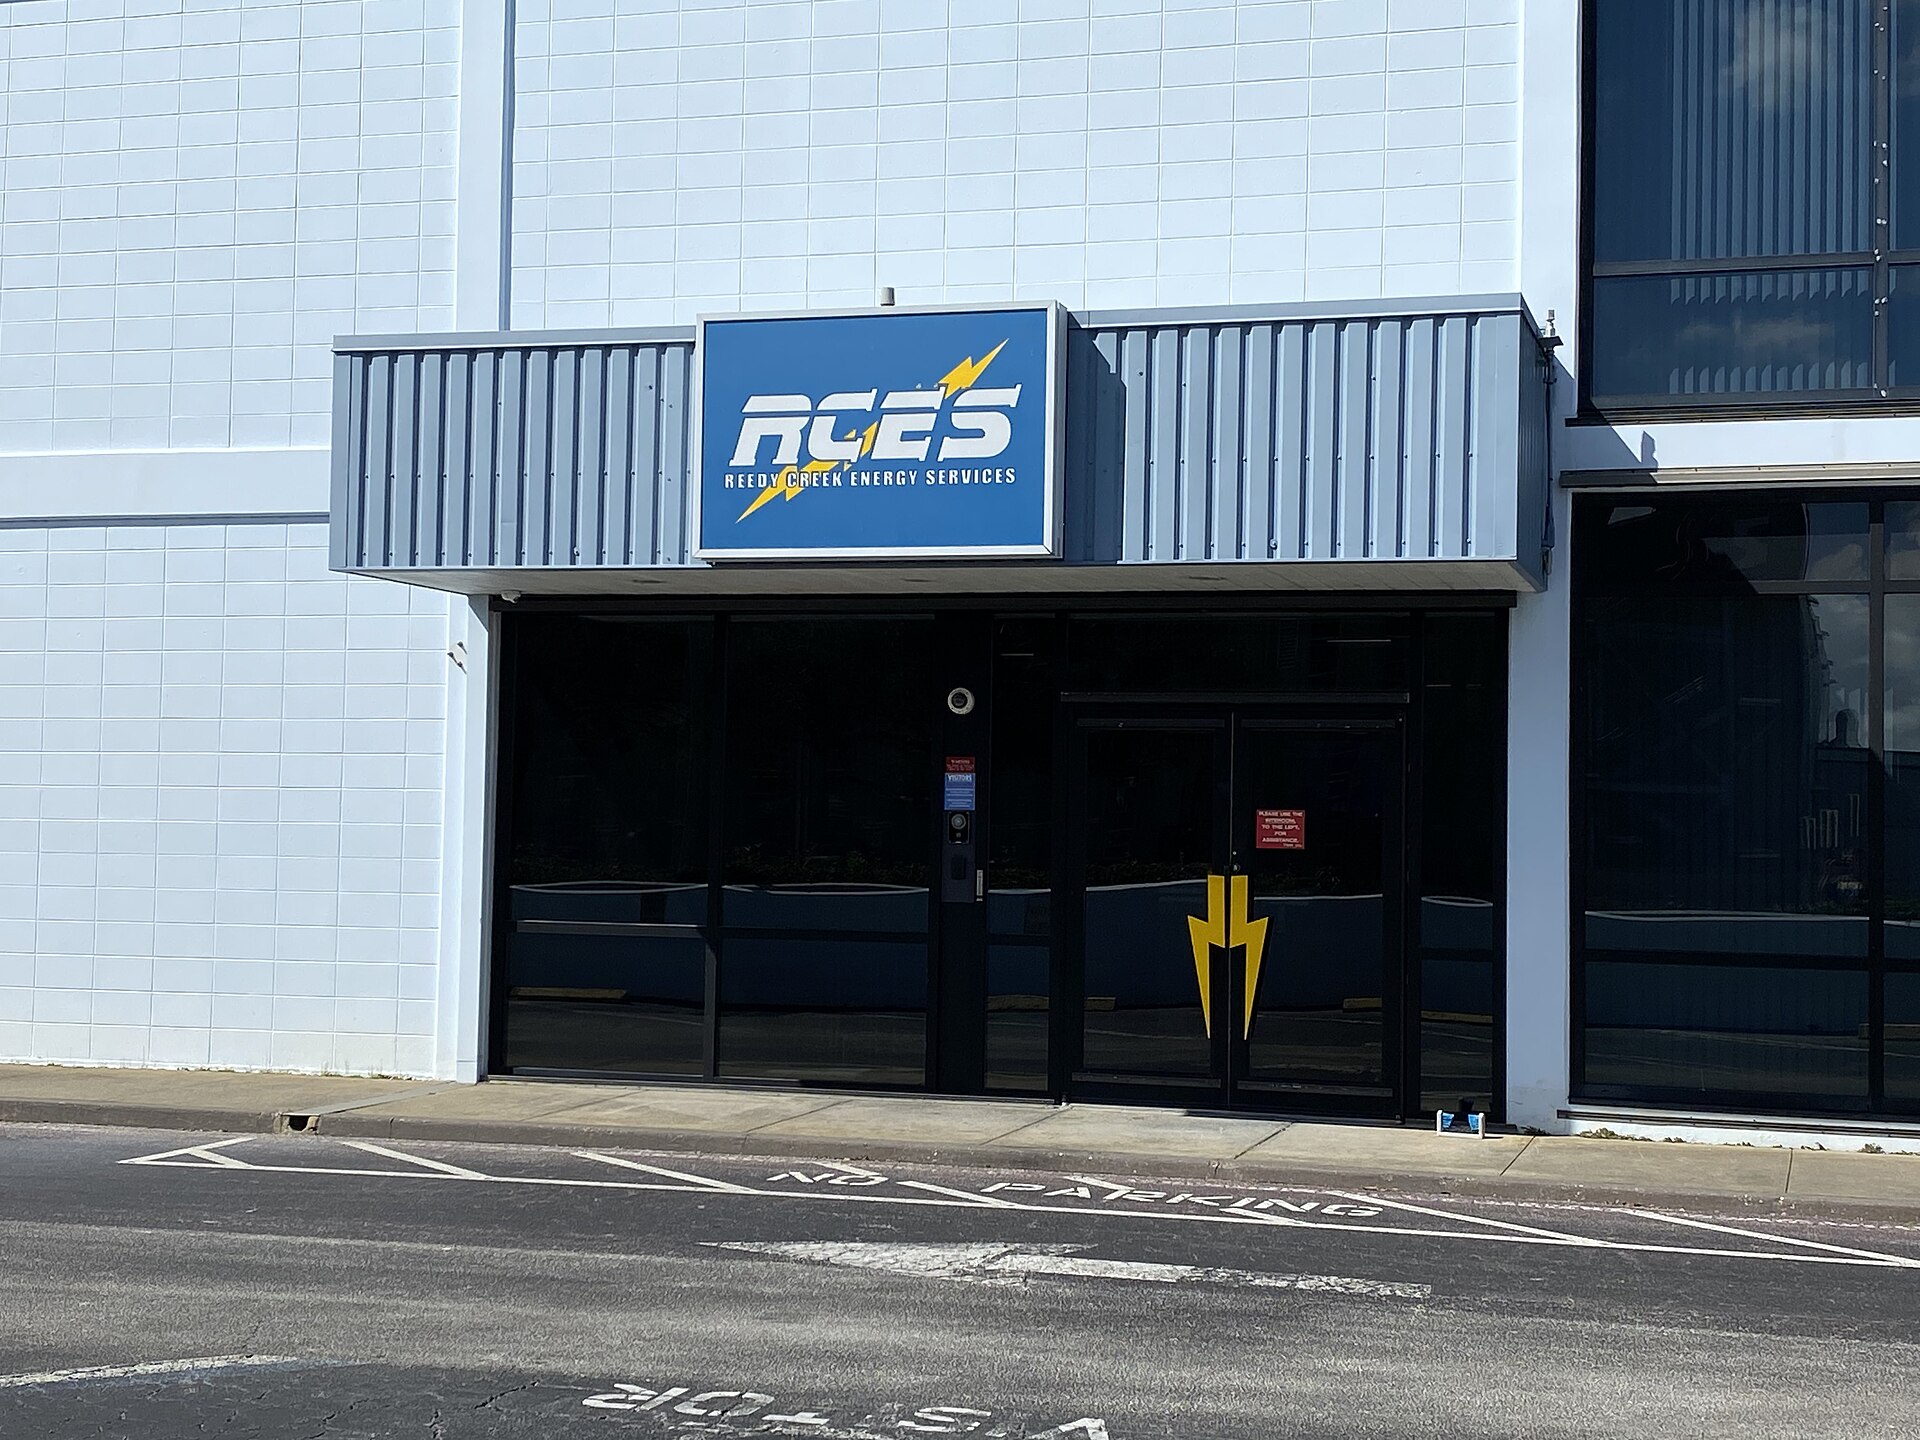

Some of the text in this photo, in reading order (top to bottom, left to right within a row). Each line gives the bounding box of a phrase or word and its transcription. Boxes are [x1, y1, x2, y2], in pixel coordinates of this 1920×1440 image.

[728, 383, 1022, 467] RCES
[724, 468, 1016, 489] REEDY CREEK ENERGY SERVICES
[766, 1171, 1384, 1217] NO PARKING
